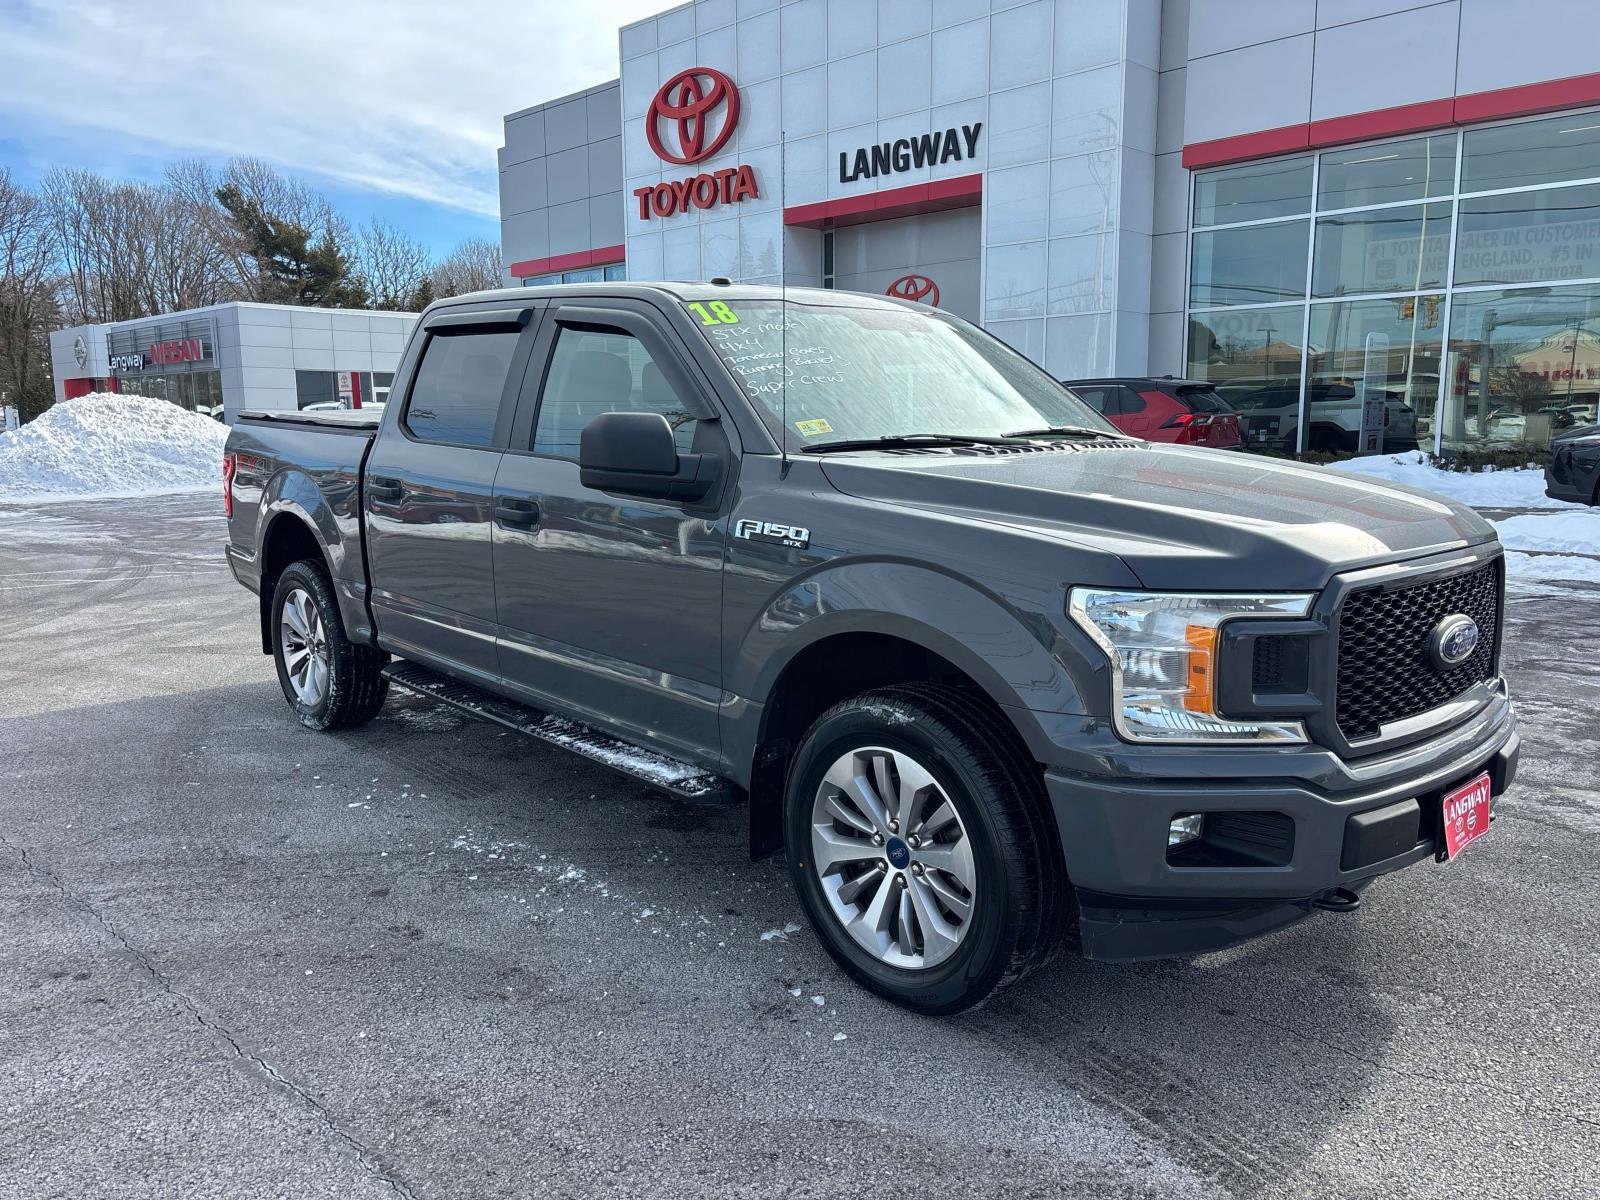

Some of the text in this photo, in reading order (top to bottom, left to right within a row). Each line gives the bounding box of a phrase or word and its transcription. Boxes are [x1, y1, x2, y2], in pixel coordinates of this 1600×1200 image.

[838, 122, 982, 183] LANGWAY
[634, 165, 759, 220] TOYOTA
[1503, 230, 1520, 246] IN
[1576, 243, 1593, 260] IN
[1539, 264, 1583, 279] TOYOTA
[687, 300, 741, 326] 18
[711, 325, 752, 340] STX
[108, 337, 204, 371] Langway NISSAN
[746, 370, 847, 397] Super Crew
[783, 540, 802, 548] STX
[1444, 784, 1489, 827] LANGWAY
